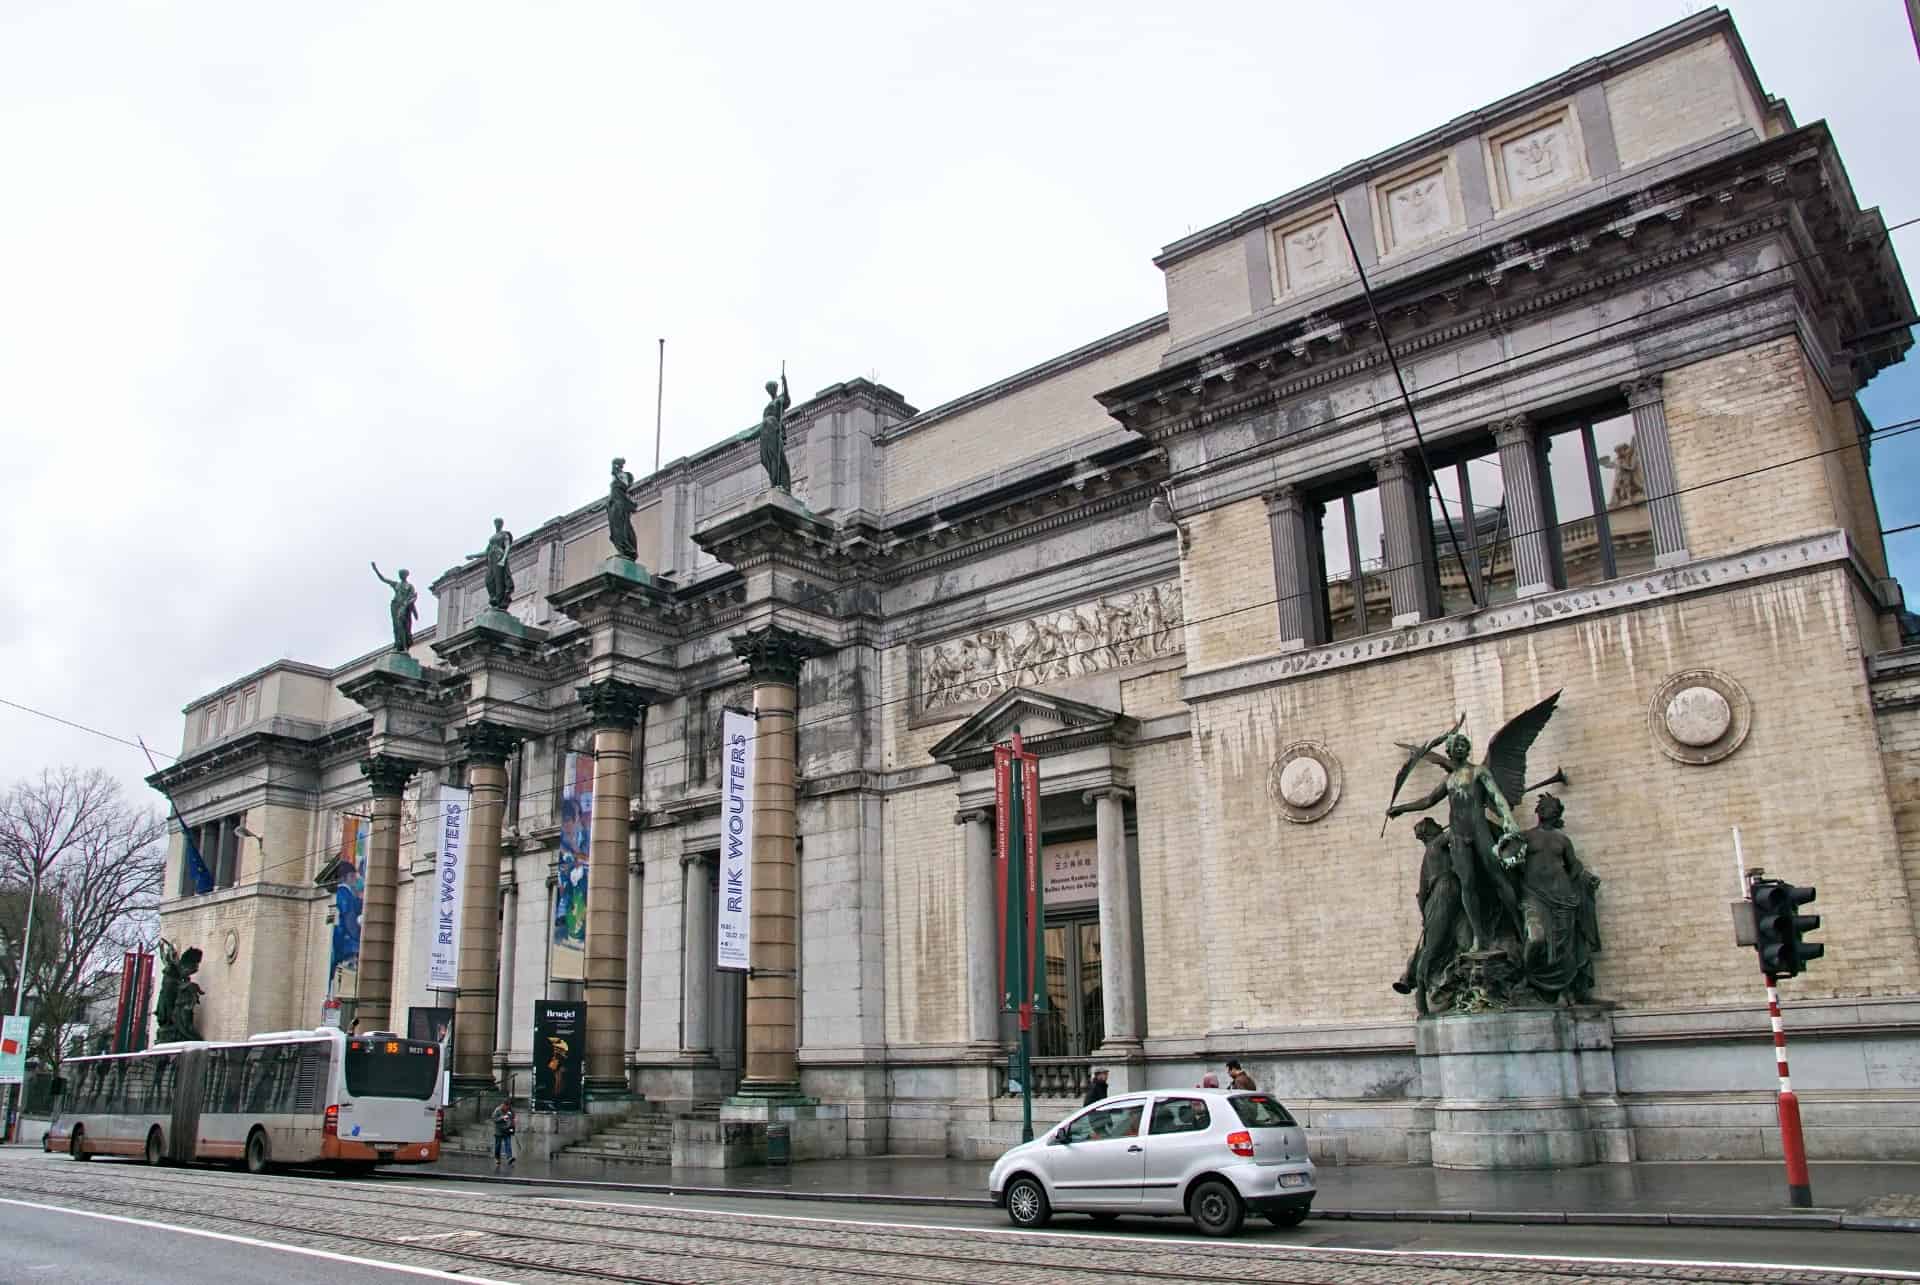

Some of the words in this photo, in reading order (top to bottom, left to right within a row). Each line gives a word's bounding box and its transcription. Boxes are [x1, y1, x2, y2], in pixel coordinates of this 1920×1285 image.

[728, 733, 746, 859] WOUTERS
[440, 803, 462, 902] WOUTERS
[727, 868, 743, 912] RIK
[438, 909, 454, 944] RIK
